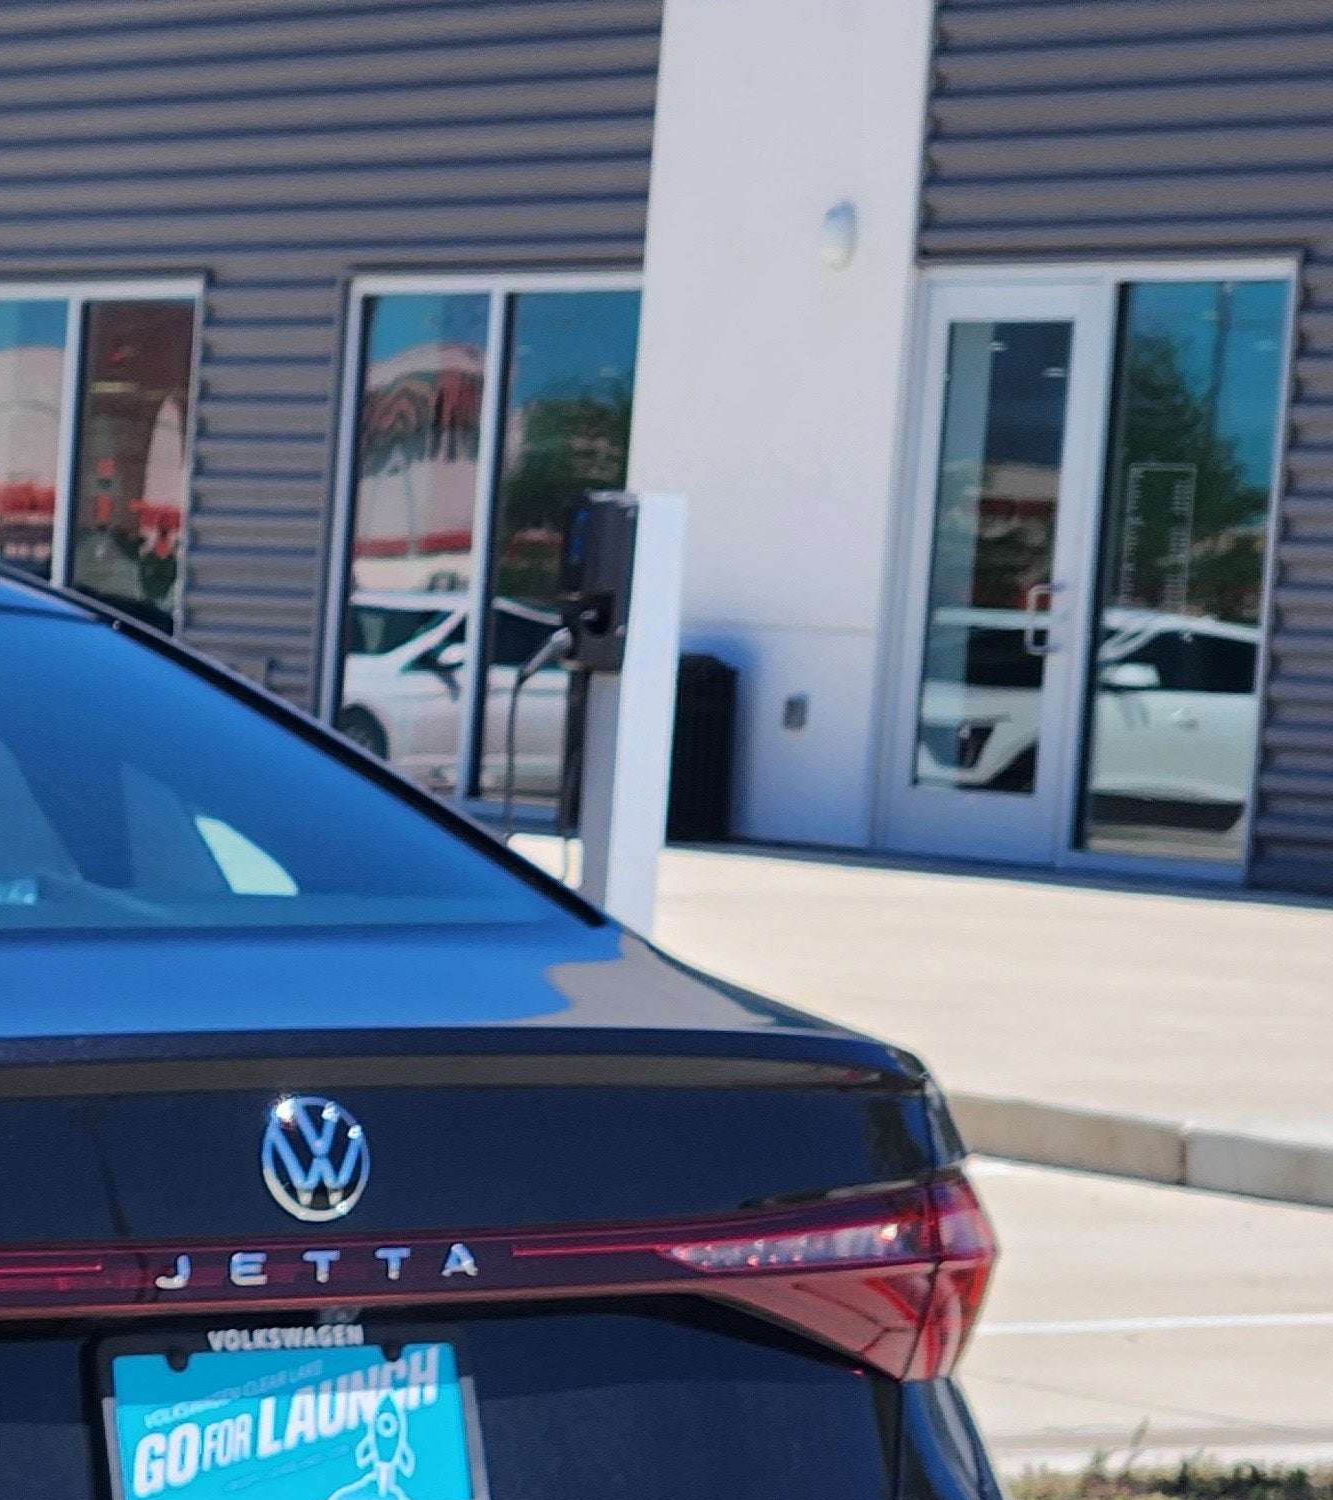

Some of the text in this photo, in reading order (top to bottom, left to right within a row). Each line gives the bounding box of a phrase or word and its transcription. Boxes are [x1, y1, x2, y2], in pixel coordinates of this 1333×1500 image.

[155, 1242, 479, 1290] JETTA
[207, 1324, 365, 1352] VOLKSWAGEN
[133, 1422, 201, 1498] GO
[202, 1412, 253, 1472] FOR
[255, 1344, 439, 1459] LAUNCH
